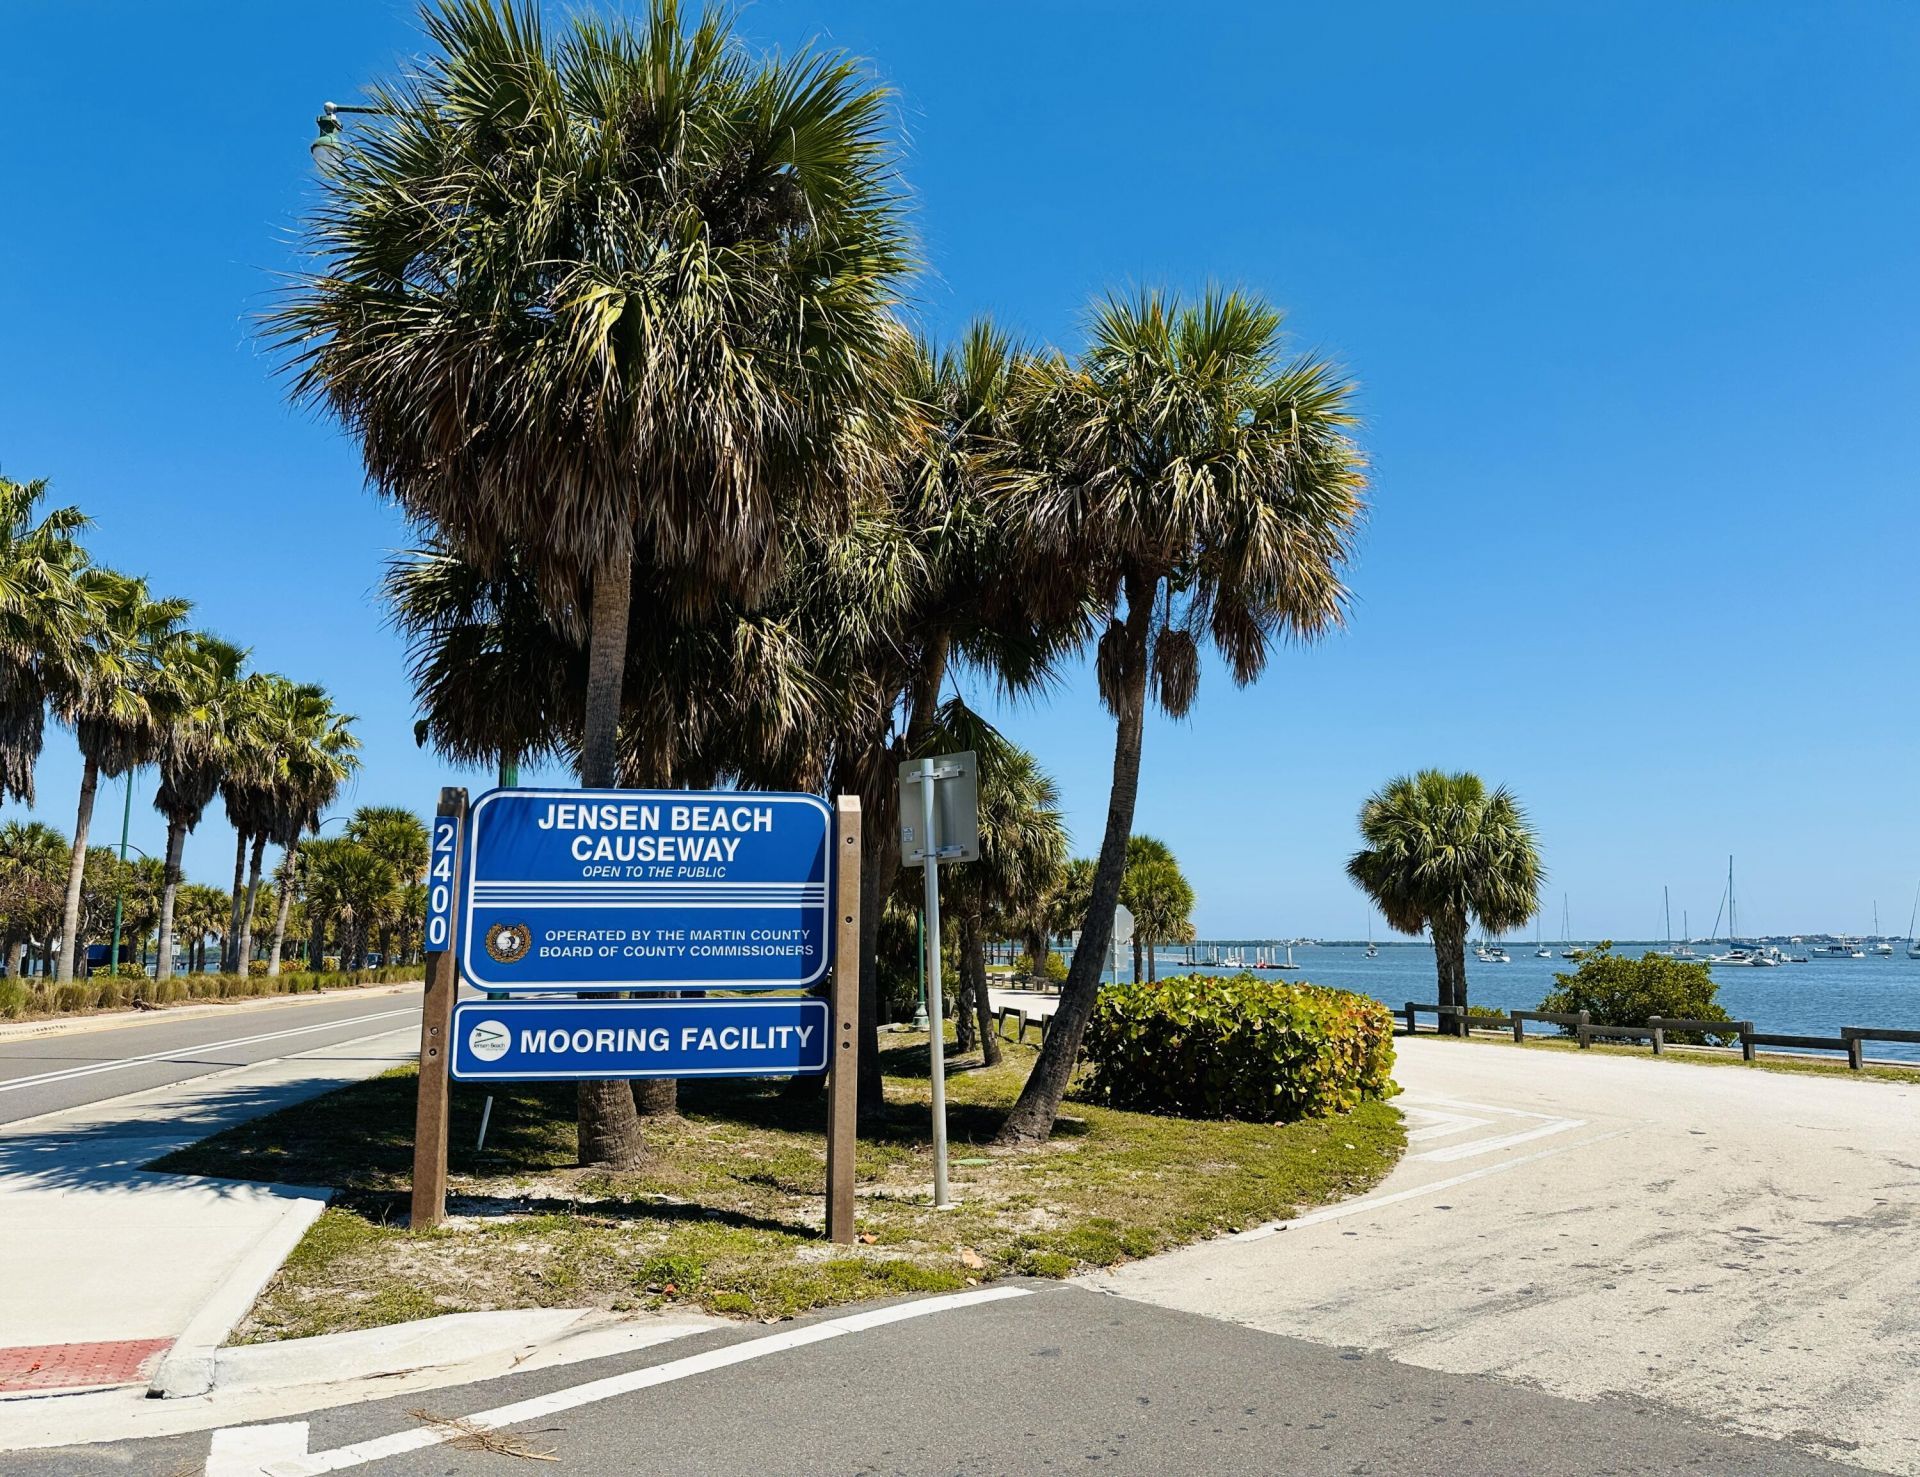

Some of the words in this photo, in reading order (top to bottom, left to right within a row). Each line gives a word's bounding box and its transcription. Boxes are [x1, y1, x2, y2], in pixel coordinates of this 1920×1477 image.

[539, 805, 659, 830] JENSEN
[672, 807, 772, 832] BEACH
[572, 835, 740, 861] CAUSEWAY
[429, 823, 454, 945] 2400
[583, 866, 620, 878] OPEN
[626, 866, 642, 877] TO
[649, 867, 674, 877] THE
[678, 867, 725, 877] PUBLIC
[546, 931, 626, 940] OPERATED
[632, 931, 650, 940] BY
[657, 931, 684, 940] THE
[690, 930, 745, 940] MARTIN
[751, 930, 809, 940] COUNTY
[540, 947, 593, 957] BOARD
[599, 946, 618, 956] OF
[624, 946, 685, 956] COUNTY
[690, 945, 813, 956] COMMISSIONERS
[521, 1028, 669, 1053] MOORING
[682, 1026, 813, 1050] FACILITY
